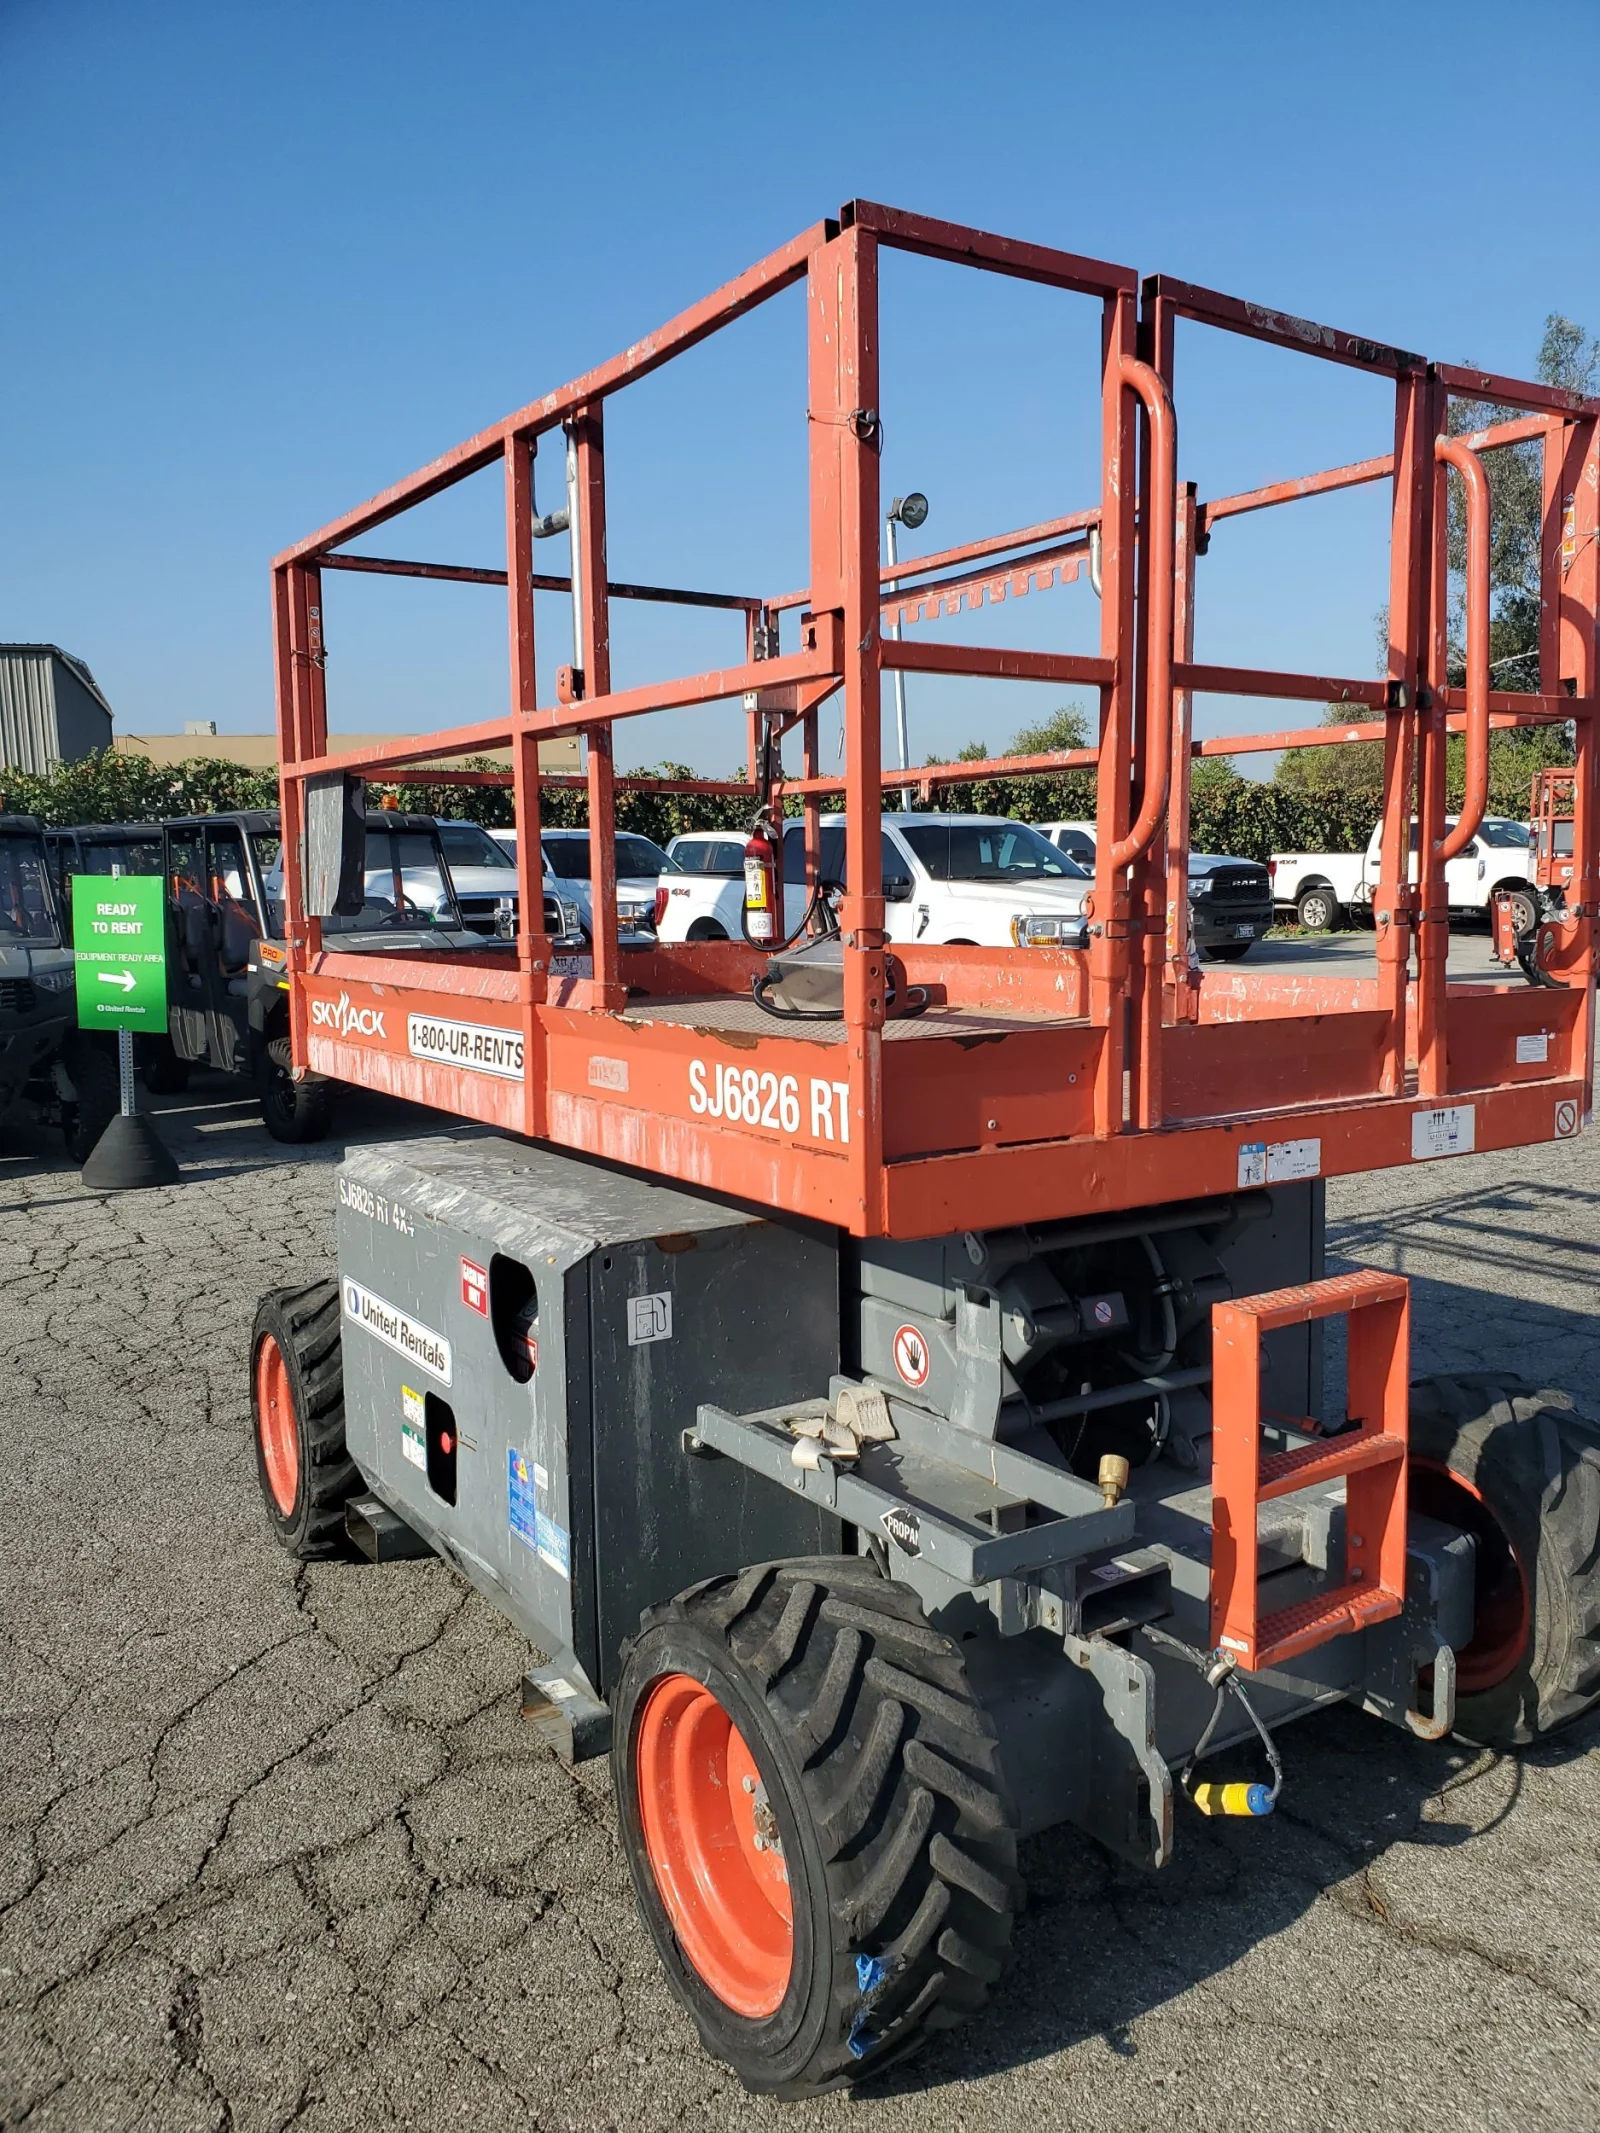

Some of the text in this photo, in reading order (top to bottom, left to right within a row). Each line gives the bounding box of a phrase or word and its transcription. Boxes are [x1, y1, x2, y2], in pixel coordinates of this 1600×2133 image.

[96, 903, 137, 916] READY
[91, 921, 143, 934] TO RENT
[76, 952, 164, 963] EQUIPMENT READY AREA
[262, 947, 278, 959] PRO
[105, 1005, 146, 1014] United Rentals
[311, 990, 387, 1038] SKYJACK
[411, 1023, 524, 1069] 1-800-UR-RENTS
[689, 1059, 850, 1144] SJ6826 RT
[340, 1177, 375, 1218] SJ6826
[362, 1295, 446, 1372] United Rentals
